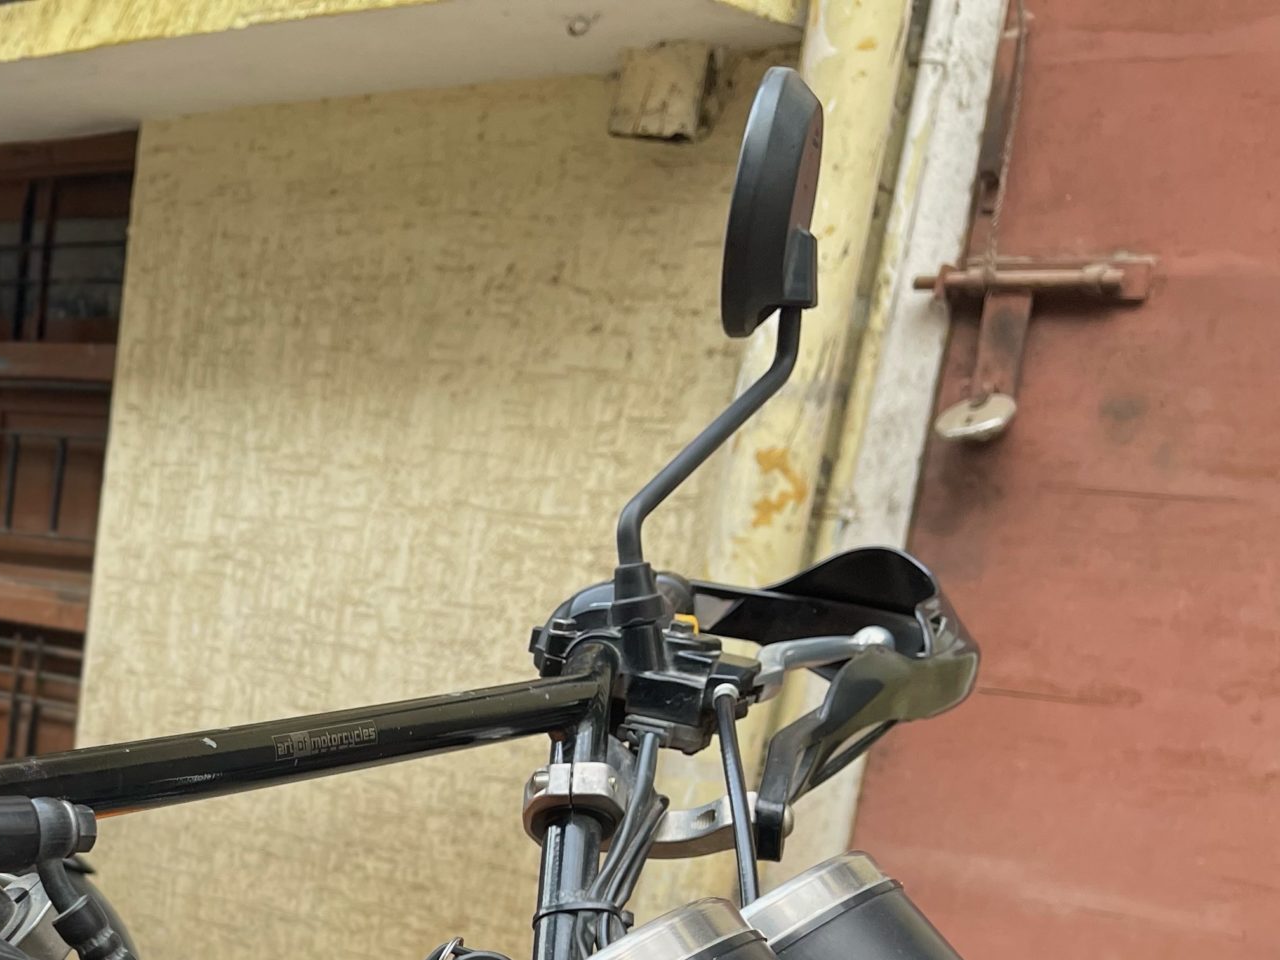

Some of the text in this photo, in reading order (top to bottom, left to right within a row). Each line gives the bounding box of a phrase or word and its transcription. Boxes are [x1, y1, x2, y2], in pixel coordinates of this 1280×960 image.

[277, 726, 376, 755] art of motorcycles
